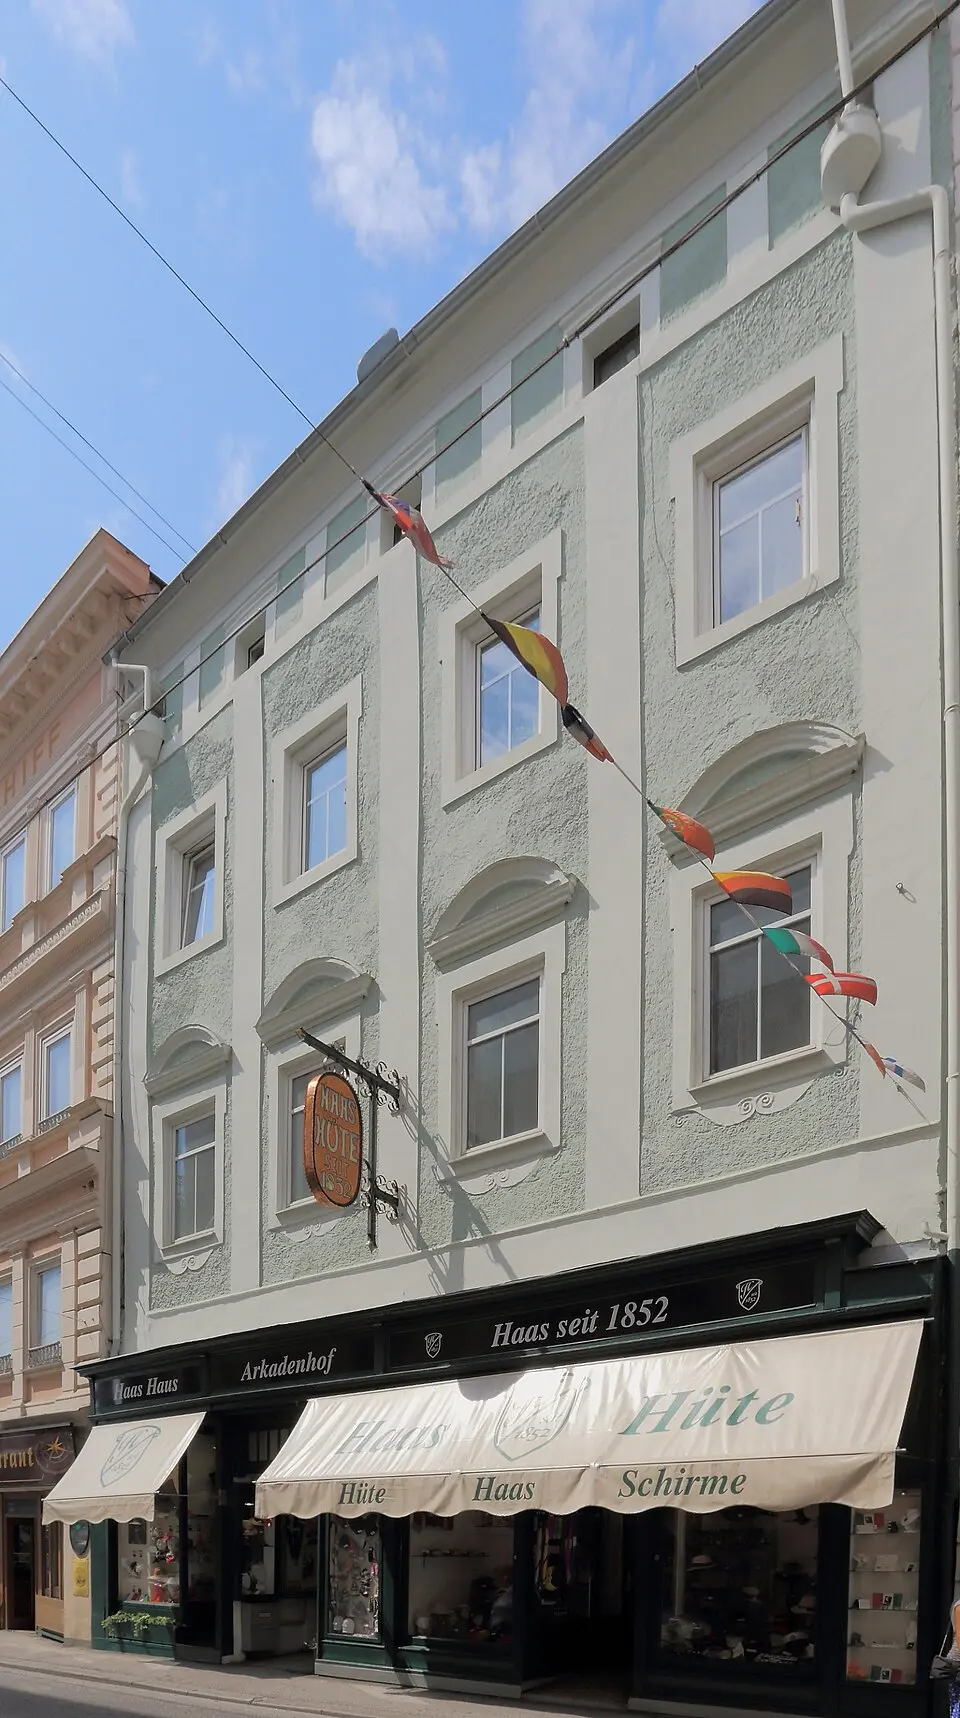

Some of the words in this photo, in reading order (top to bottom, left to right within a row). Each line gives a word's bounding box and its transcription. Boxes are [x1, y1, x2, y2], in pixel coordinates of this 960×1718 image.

[320, 1083, 357, 1125] HAAS
[315, 1115, 360, 1164] HÜTE
[320, 1171, 353, 1199] 1852
[491, 1321, 551, 1348] Haas
[556, 1308, 599, 1339] seit
[605, 1296, 669, 1331] 1852
[241, 1347, 337, 1382] Arkadenhof
[113, 1382, 143, 1401] Haas
[146, 1376, 179, 1396] Haus
[618, 1385, 796, 1437] Hüte
[335, 1420, 451, 1455] Haas
[0, 1447, 35, 1468] rant
[338, 1482, 386, 1505] Hüte
[472, 1476, 536, 1502] Haas
[617, 1468, 748, 1499] Schirme
